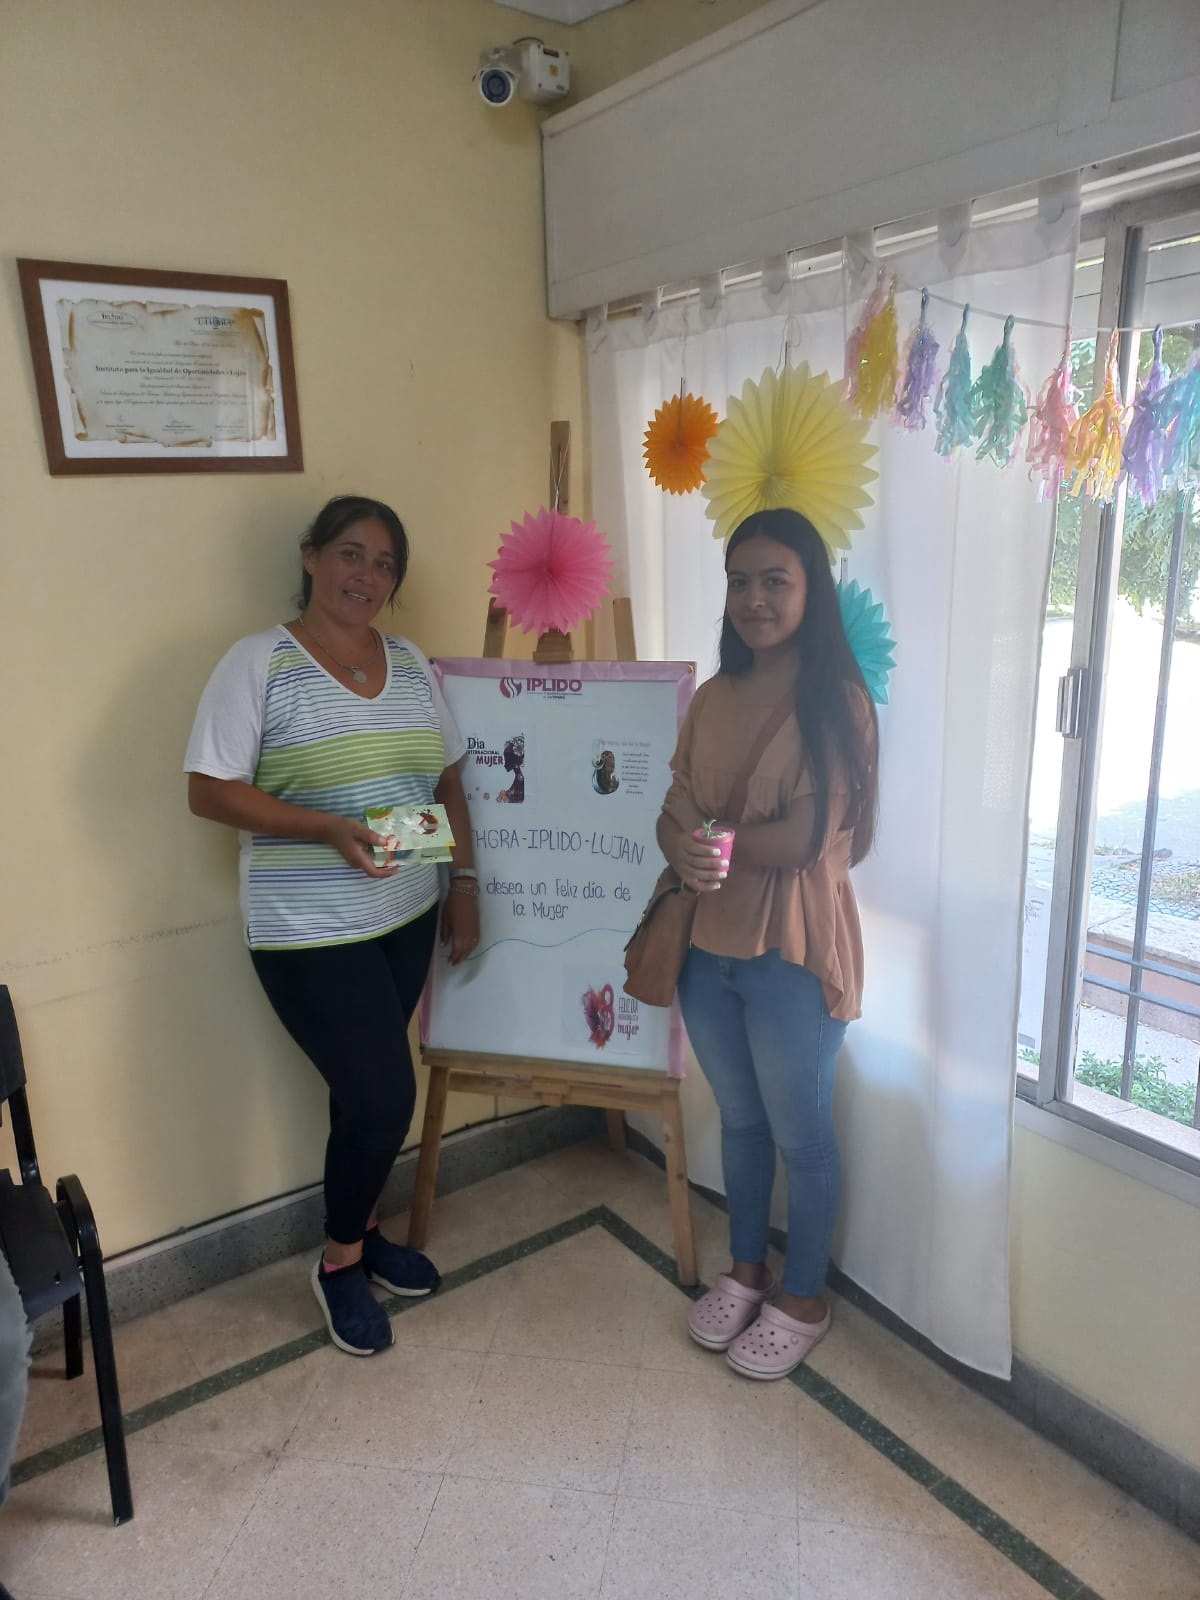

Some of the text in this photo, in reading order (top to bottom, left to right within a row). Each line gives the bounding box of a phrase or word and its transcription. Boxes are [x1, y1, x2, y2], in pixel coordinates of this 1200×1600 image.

[526, 678, 583, 692] IPLIDO
[475, 755, 504, 767] MUJER
[473, 828, 645, 866] HGRA-IPLIDO-LUJAN
[486, 876, 525, 896] desea
[530, 881, 547, 896] un
[614, 880, 632, 902] de
[512, 899, 569, 921] la Mujer
